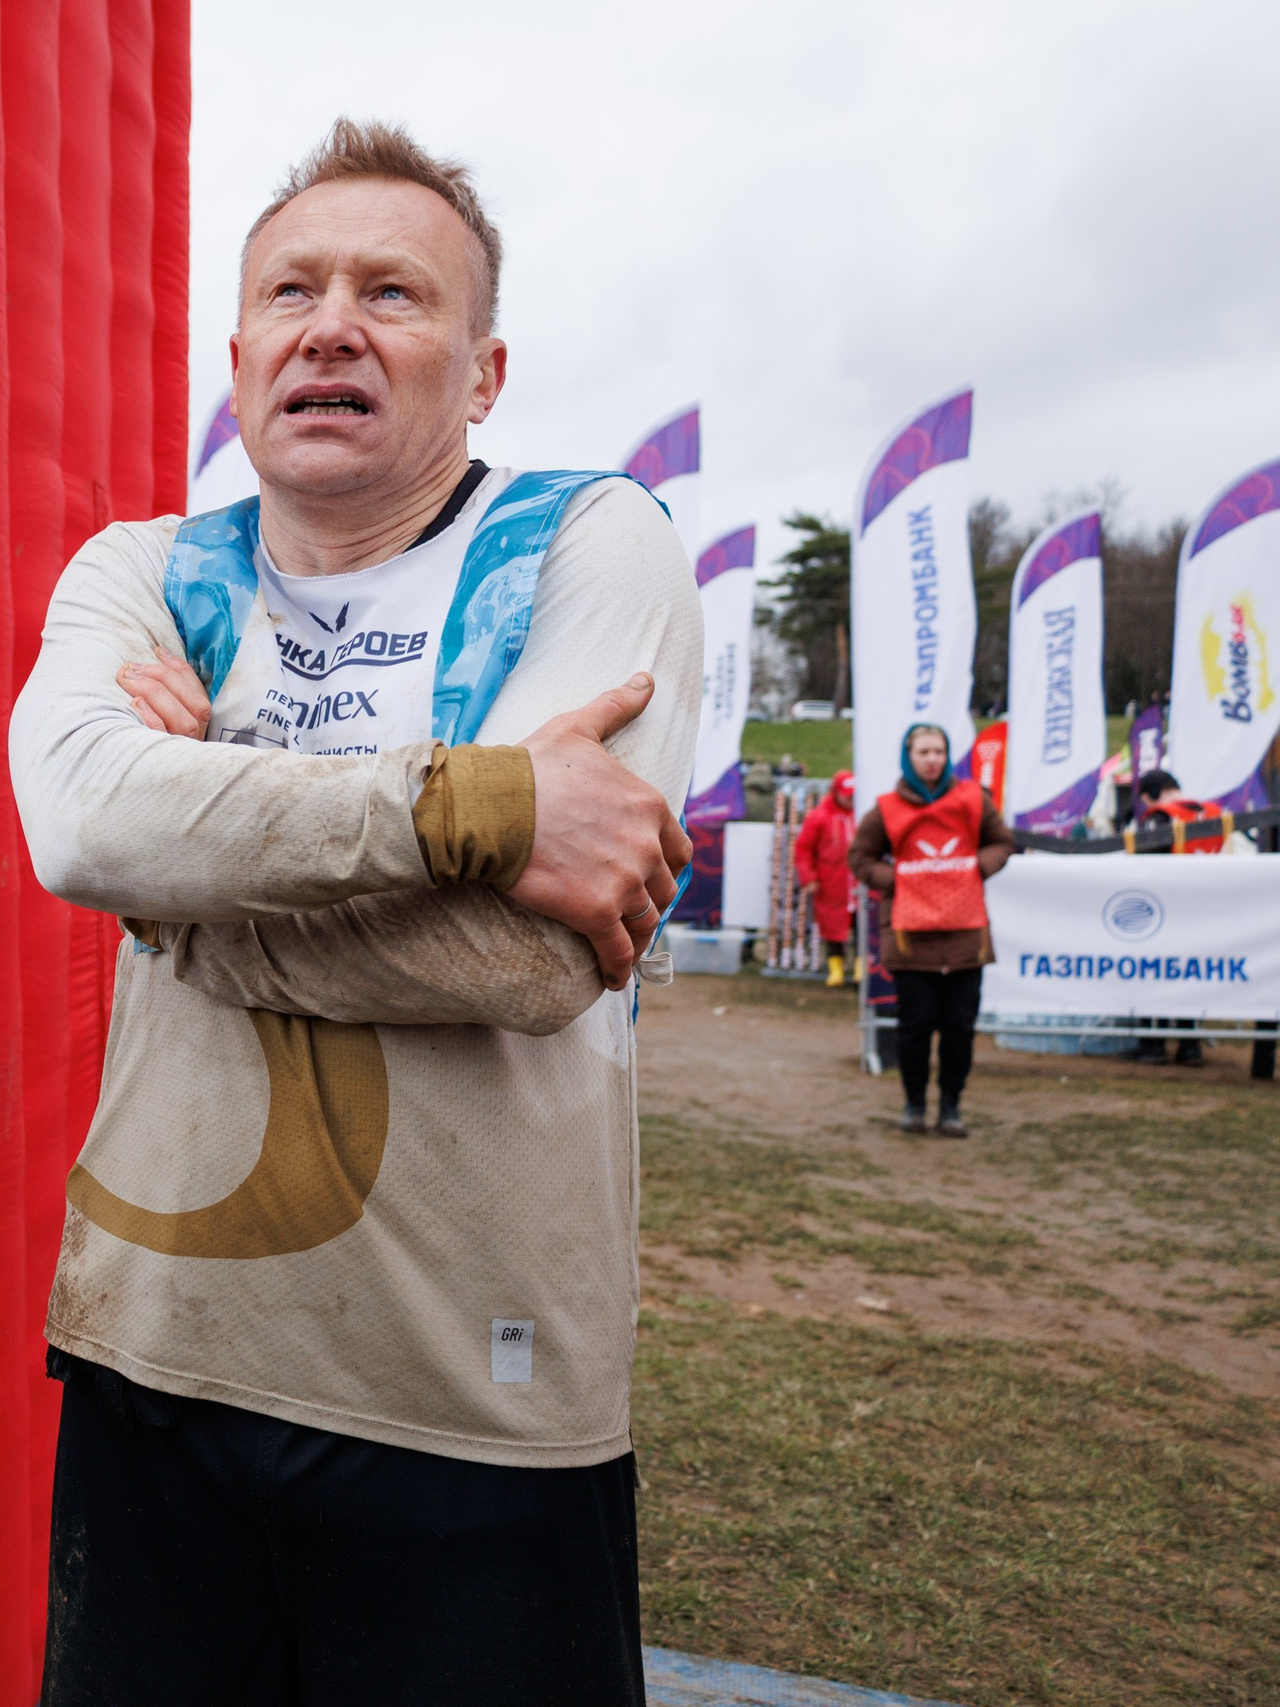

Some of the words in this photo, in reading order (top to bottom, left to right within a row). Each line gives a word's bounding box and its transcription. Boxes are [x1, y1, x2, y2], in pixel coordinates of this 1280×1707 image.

[907, 504, 938, 712] ГАЗПРОМБАНК
[329, 630, 428, 668] ГЕРОЕВ
[256, 708, 293, 733] FINE
[1019, 954, 1249, 983] ГАЗПРОМБАНК
